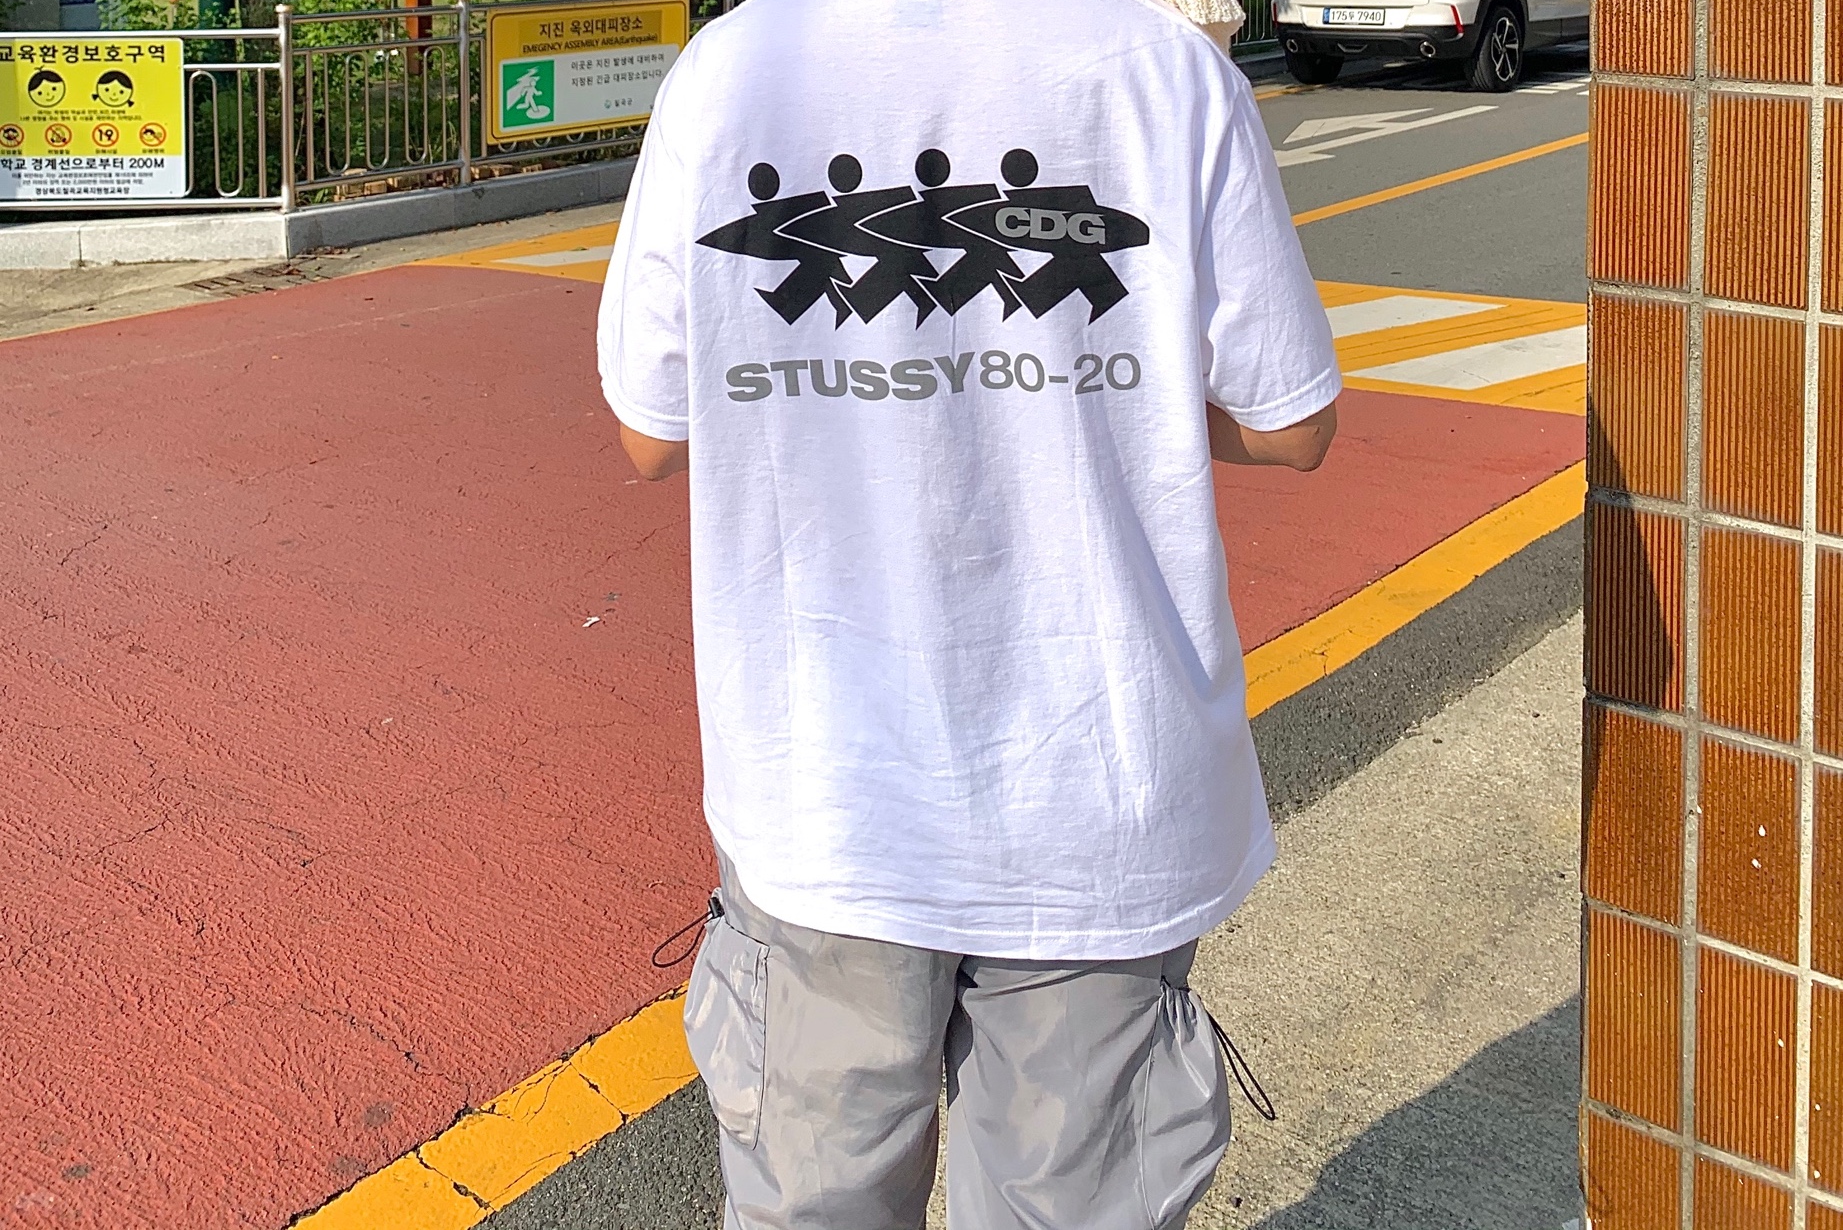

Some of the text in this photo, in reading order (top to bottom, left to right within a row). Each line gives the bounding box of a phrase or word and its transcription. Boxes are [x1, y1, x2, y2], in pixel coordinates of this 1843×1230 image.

[1357, 11, 1382, 22] 7940
[539, 16, 643, 38] 지진 옥외대피장소
[522, 41, 562, 53] EMEGENCY
[564, 38, 600, 50] ASSEMBLY
[0, 44, 165, 63] 교육환경보호구역
[571, 60, 593, 71] 이곳은
[596, 58, 611, 69] 지진
[571, 76, 594, 87] 지정된
[596, 74, 611, 85] 긴급
[0, 157, 165, 171] 학교 경계선으로부터 200M
[994, 206, 1106, 245] CDG
[725, 349, 1142, 402] STUSSY 80-20
